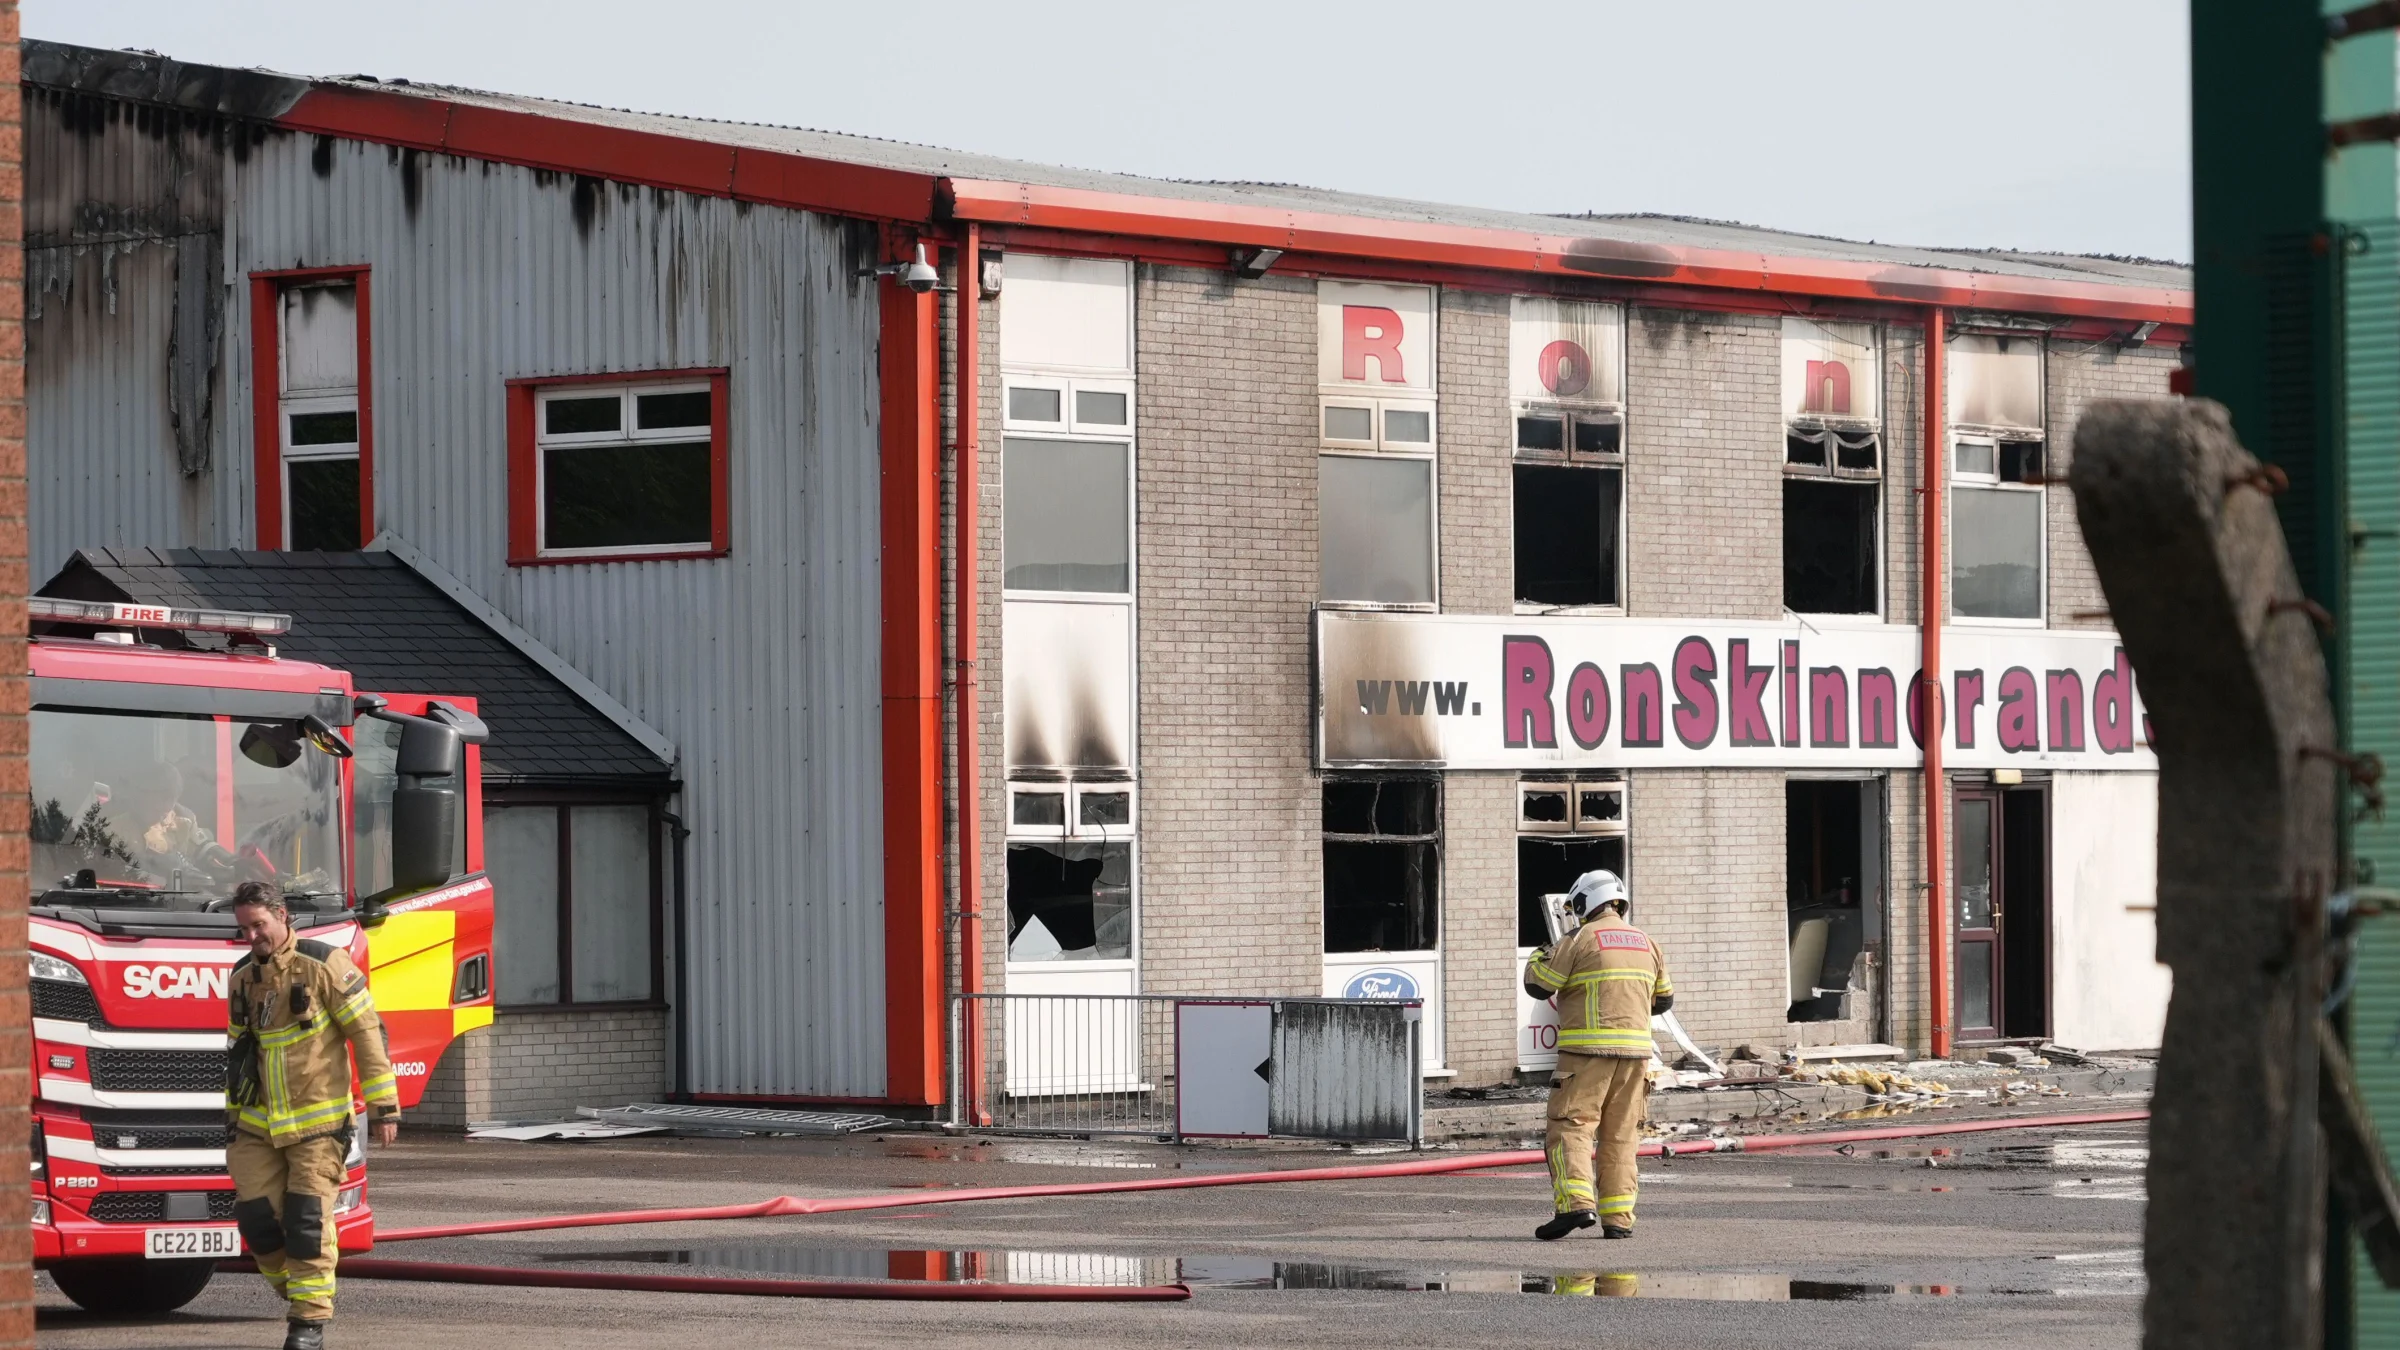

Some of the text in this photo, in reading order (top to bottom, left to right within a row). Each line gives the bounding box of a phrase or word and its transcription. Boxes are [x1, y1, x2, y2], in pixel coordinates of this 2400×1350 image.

[121, 607, 165, 621] FIRE
[1601, 934, 1646, 946] TAN FIRE
[122, 964, 234, 999] SCAN
[1527, 1024, 1561, 1050] TO
[391, 1061, 426, 1077] ARGOD
[152, 1231, 235, 1254] CE22 BBJ
